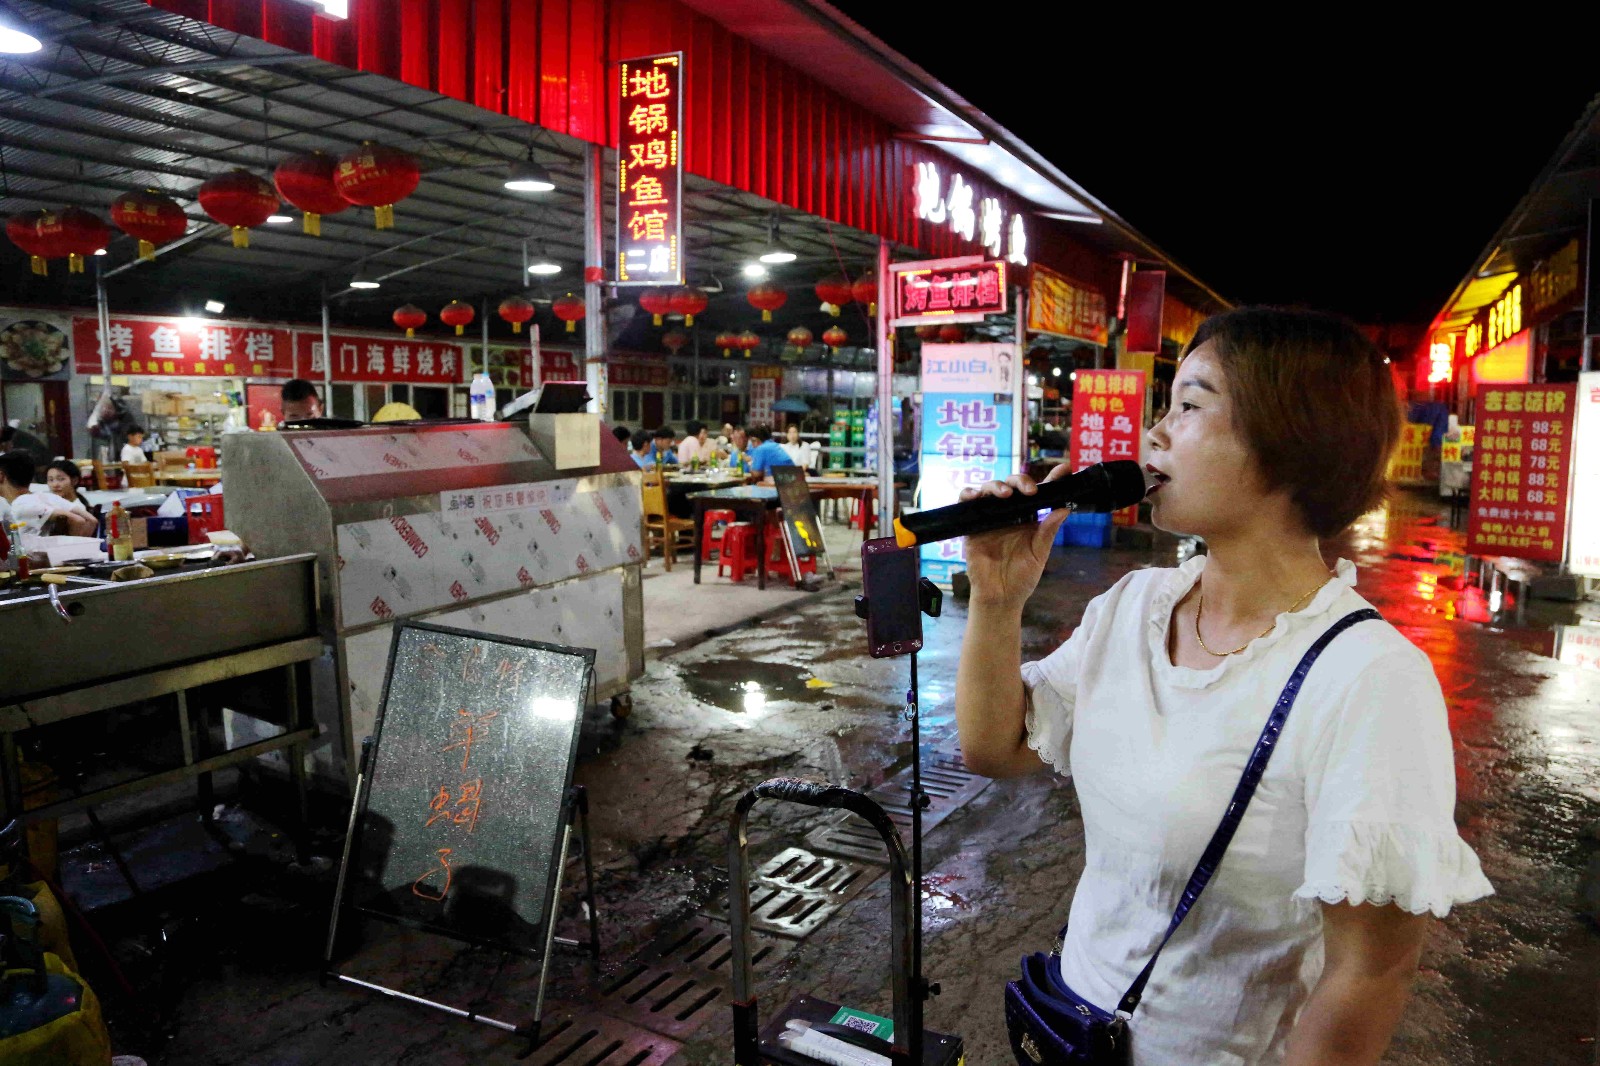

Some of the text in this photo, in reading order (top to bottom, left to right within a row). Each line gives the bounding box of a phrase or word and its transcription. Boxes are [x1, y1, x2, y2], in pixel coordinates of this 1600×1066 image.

[628, 66, 670, 241] 地锅鸡鱼馆
[904, 269, 999, 312] 烤鱼排档
[96, 323, 274, 362] 烤鱼排档
[311, 341, 457, 377] 厦门海鲜烧烤
[926, 358, 988, 375] 江小白
[1079, 373, 1138, 395] 烤鱼排档
[1089, 396, 1126, 412] 特色
[1532, 420, 1563, 435] 98元
[1079, 412, 1105, 472] 地锅鸡
[1530, 437, 1561, 453] 68元
[1530, 455, 1560, 471] 78元
[1528, 472, 1559, 488] 88元
[1527, 489, 1558, 506] 68元
